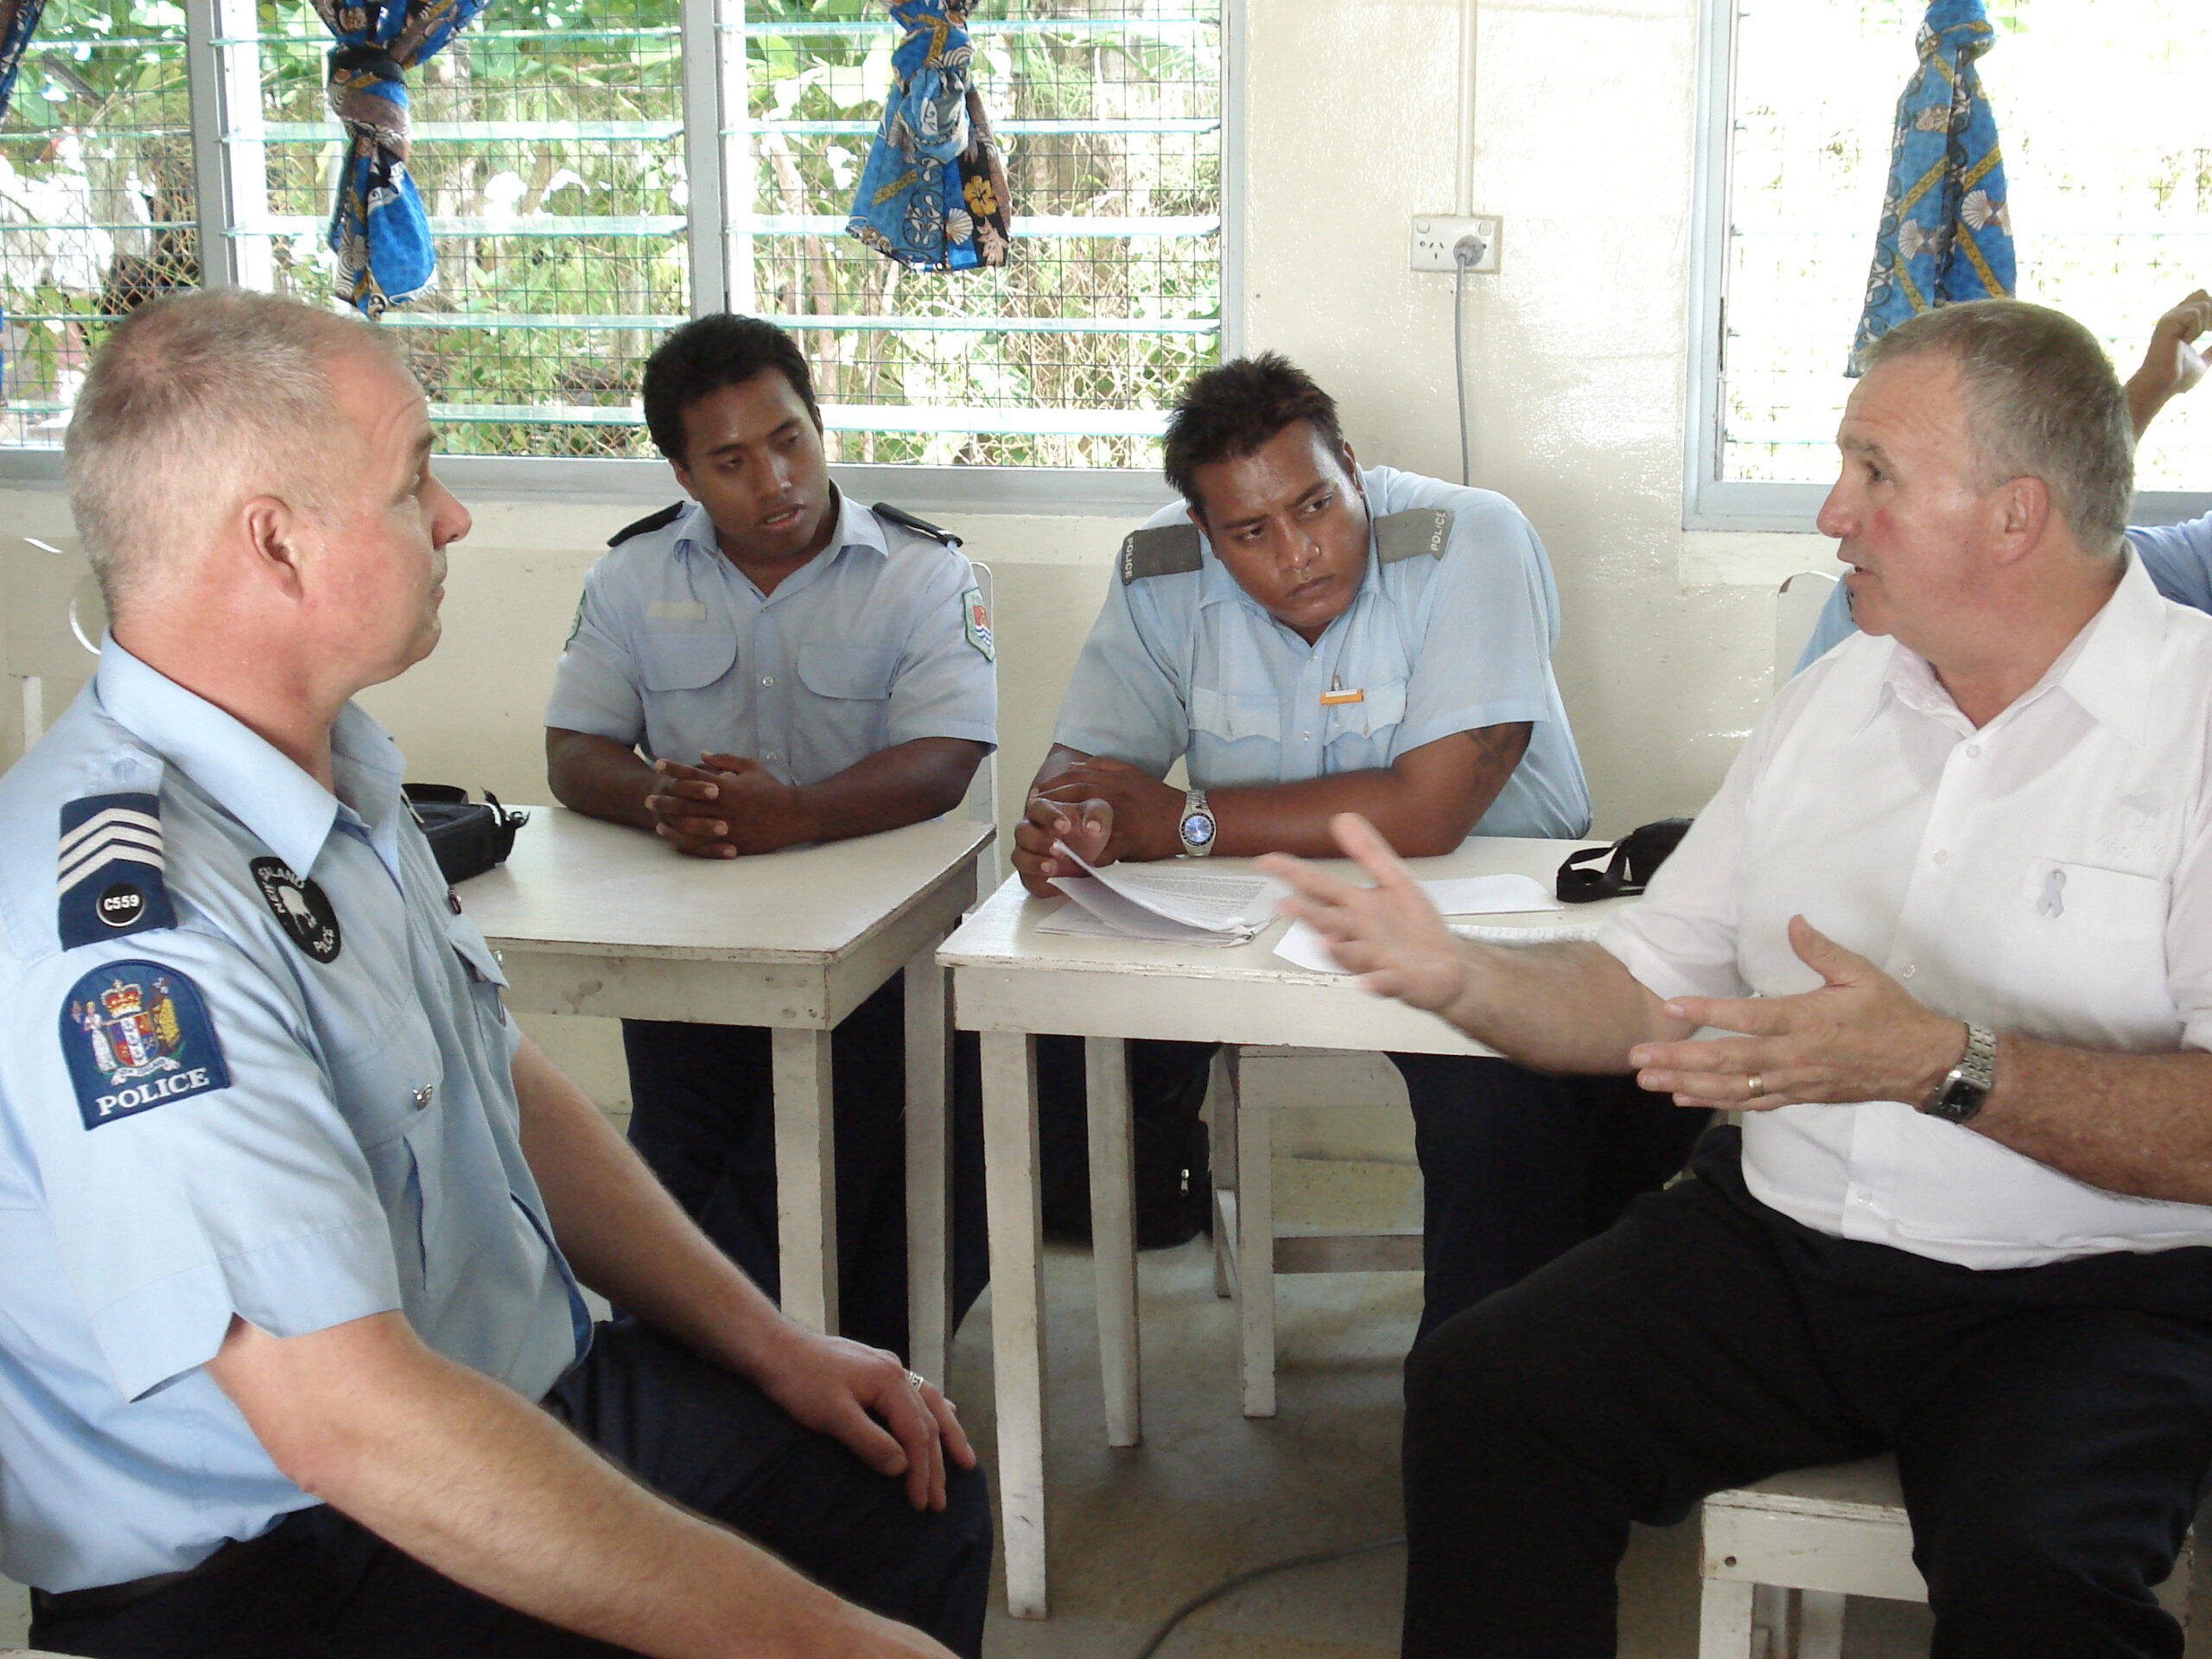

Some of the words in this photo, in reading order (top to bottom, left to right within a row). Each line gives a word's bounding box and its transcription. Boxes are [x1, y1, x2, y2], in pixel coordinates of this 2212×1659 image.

[1430, 512, 1446, 551] POLICE
[1125, 537, 1134, 579] POLICE
[104, 894, 140, 912] C559
[95, 1067, 210, 1116] POLICE
